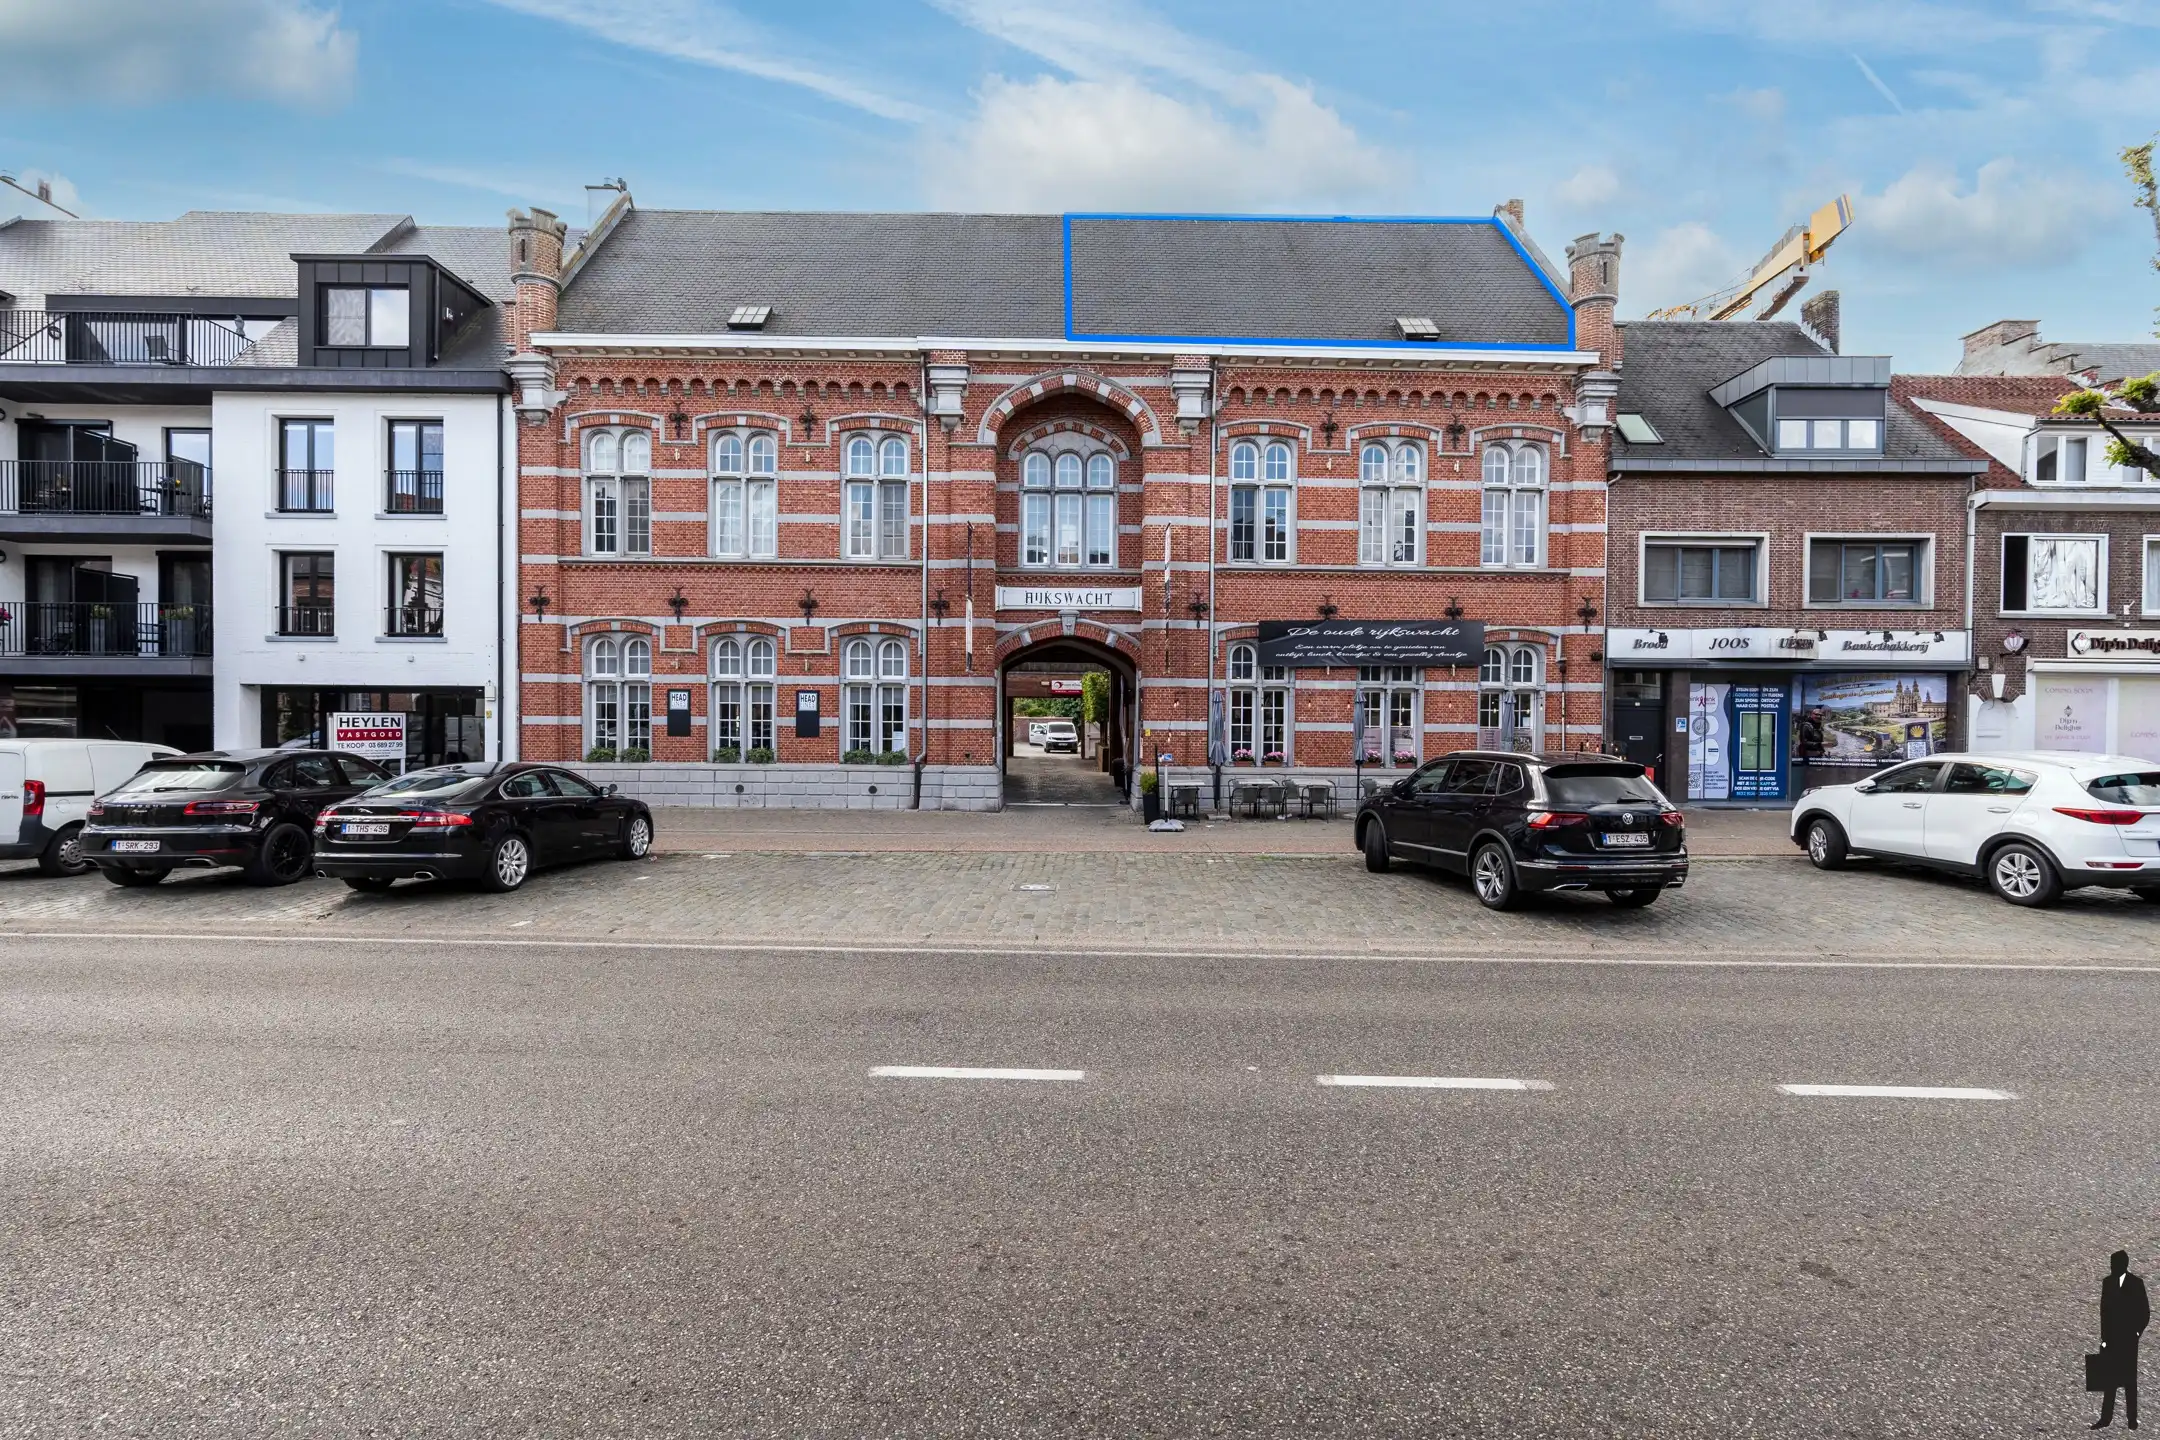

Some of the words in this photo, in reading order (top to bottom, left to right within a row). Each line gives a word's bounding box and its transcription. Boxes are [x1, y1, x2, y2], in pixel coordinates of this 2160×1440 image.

[1287, 627, 1320, 636] De
[1323, 626, 1365, 636] oude
[1368, 626, 1460, 639] rijkswacht
[1708, 637, 1750, 650] JOOS
[1841, 640, 1930, 654] Banketbakkerij
[671, 693, 687, 701] HEAD
[800, 694, 816, 702] HEAD
[339, 717, 401, 728] HEYLEN
